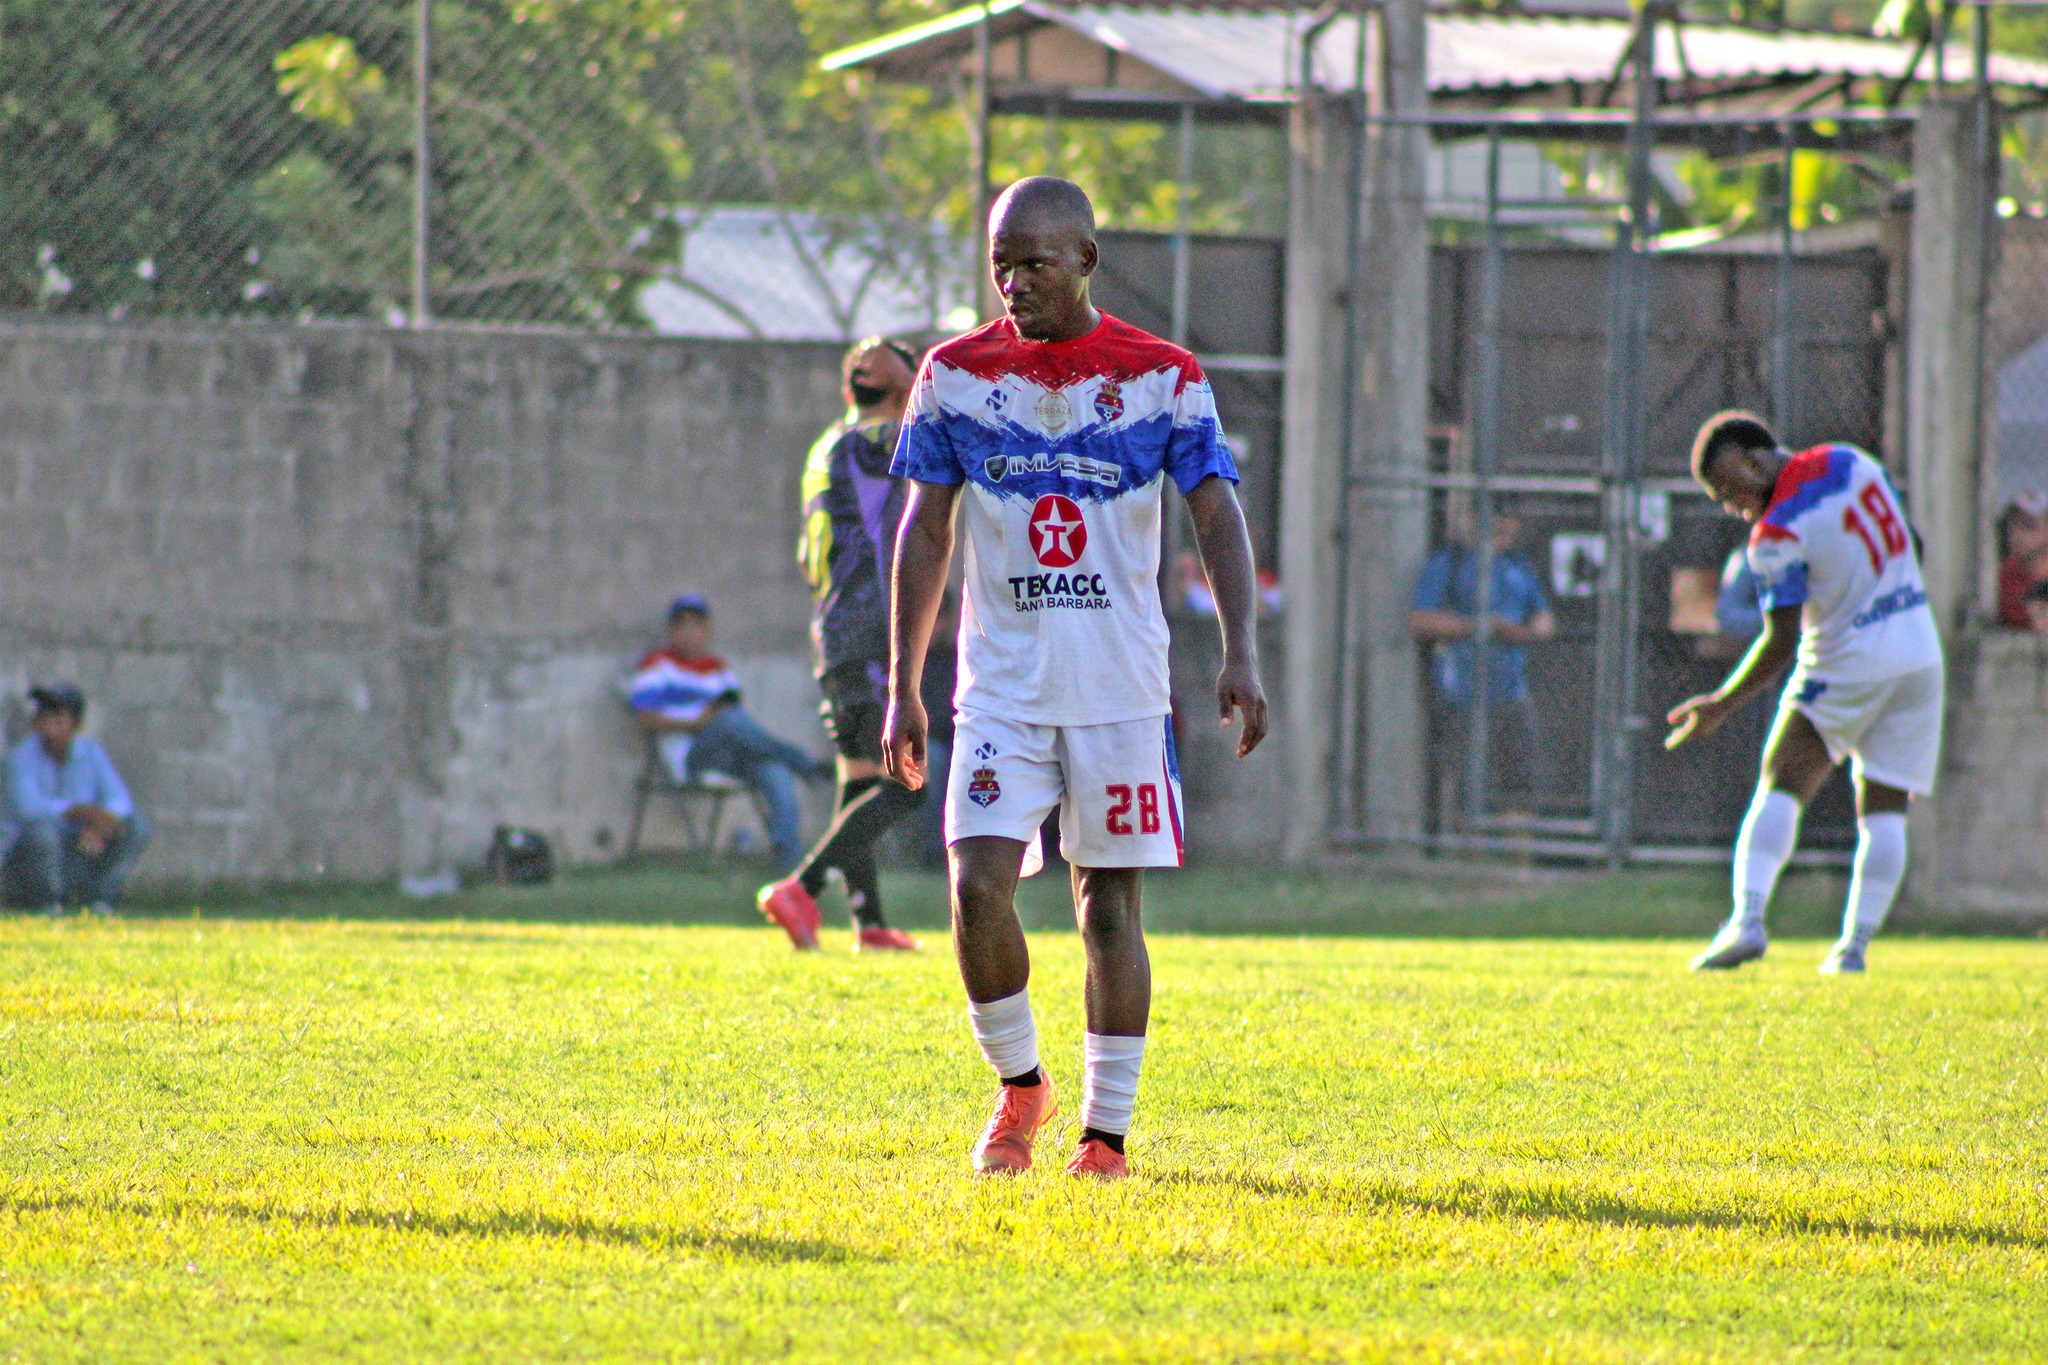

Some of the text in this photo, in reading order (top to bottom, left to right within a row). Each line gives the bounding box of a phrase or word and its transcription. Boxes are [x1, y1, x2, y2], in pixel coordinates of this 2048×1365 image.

[1034, 406, 1072, 417] TERRAZA
[1842, 480, 1907, 578] 18
[1008, 573, 1107, 600] TEXACO
[1047, 597, 1113, 609] BARBARA
[1105, 782, 1161, 836] 28
